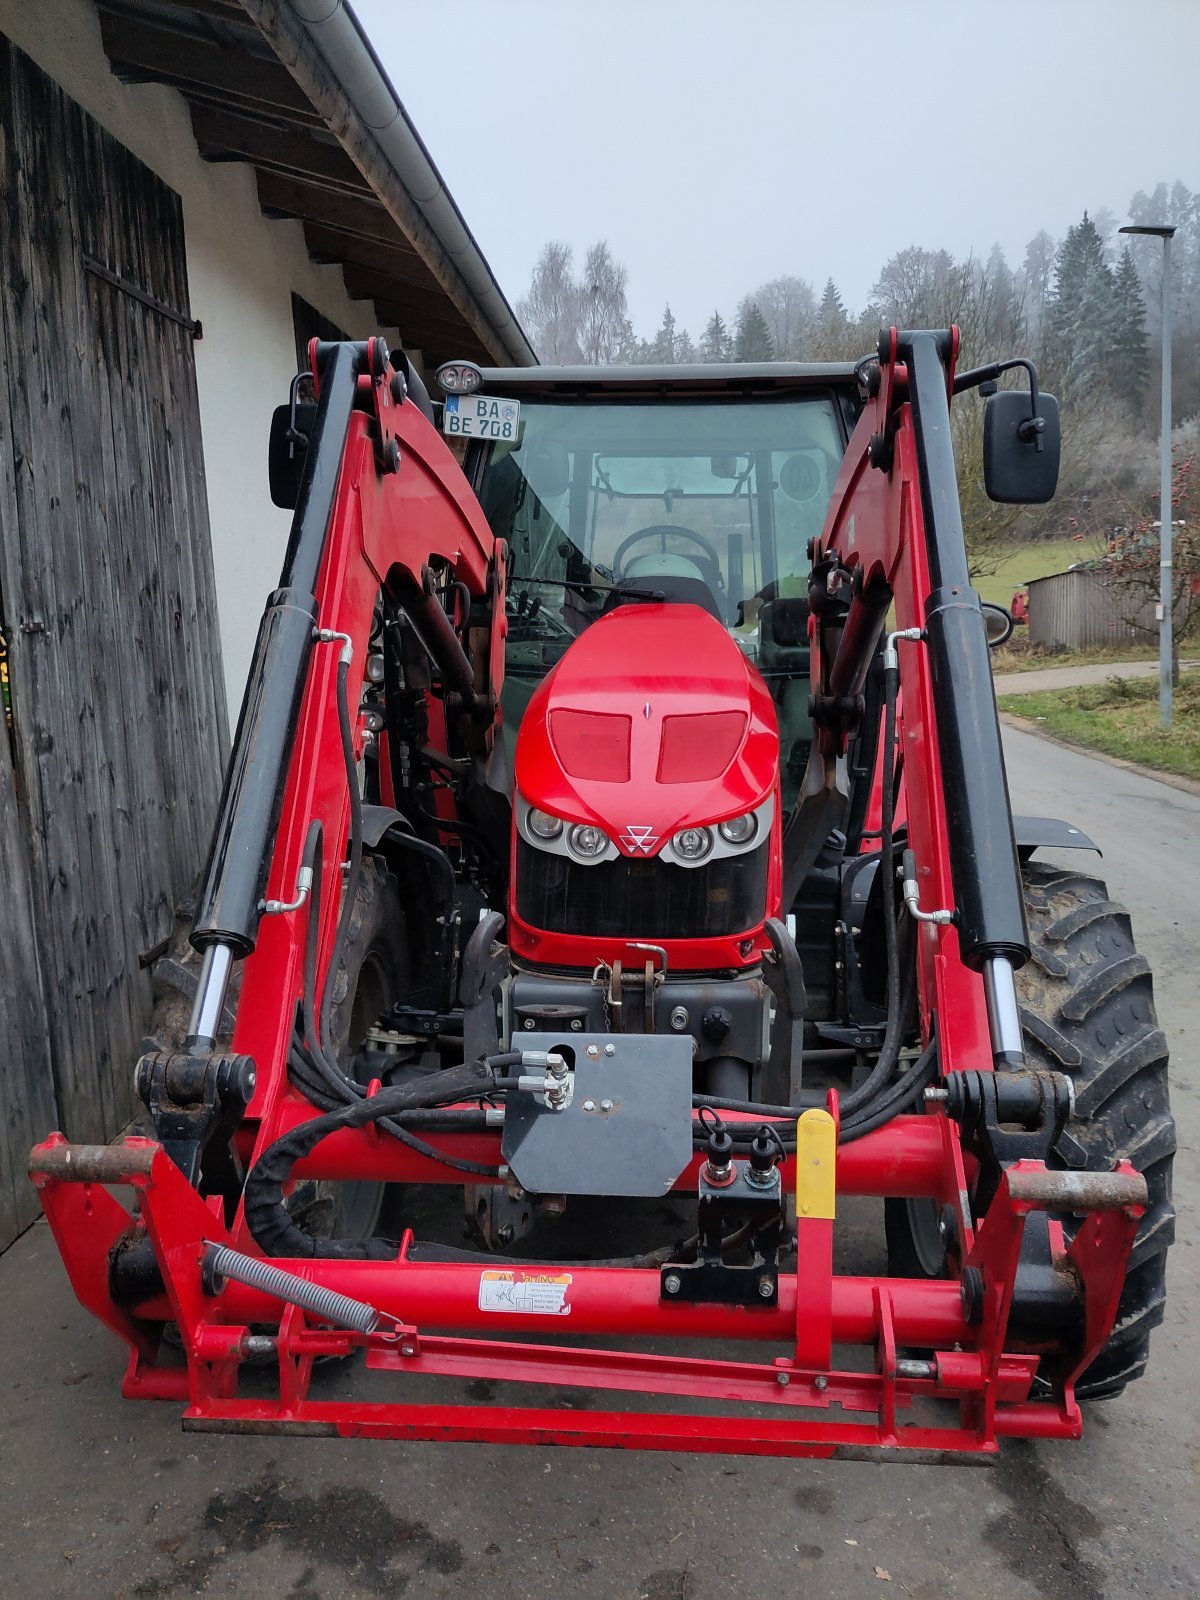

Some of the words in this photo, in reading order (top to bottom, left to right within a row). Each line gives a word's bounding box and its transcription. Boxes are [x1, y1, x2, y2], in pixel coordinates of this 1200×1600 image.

[477, 400, 499, 418] BA
[449, 416, 473, 434] BE
[479, 419, 512, 438] 708
